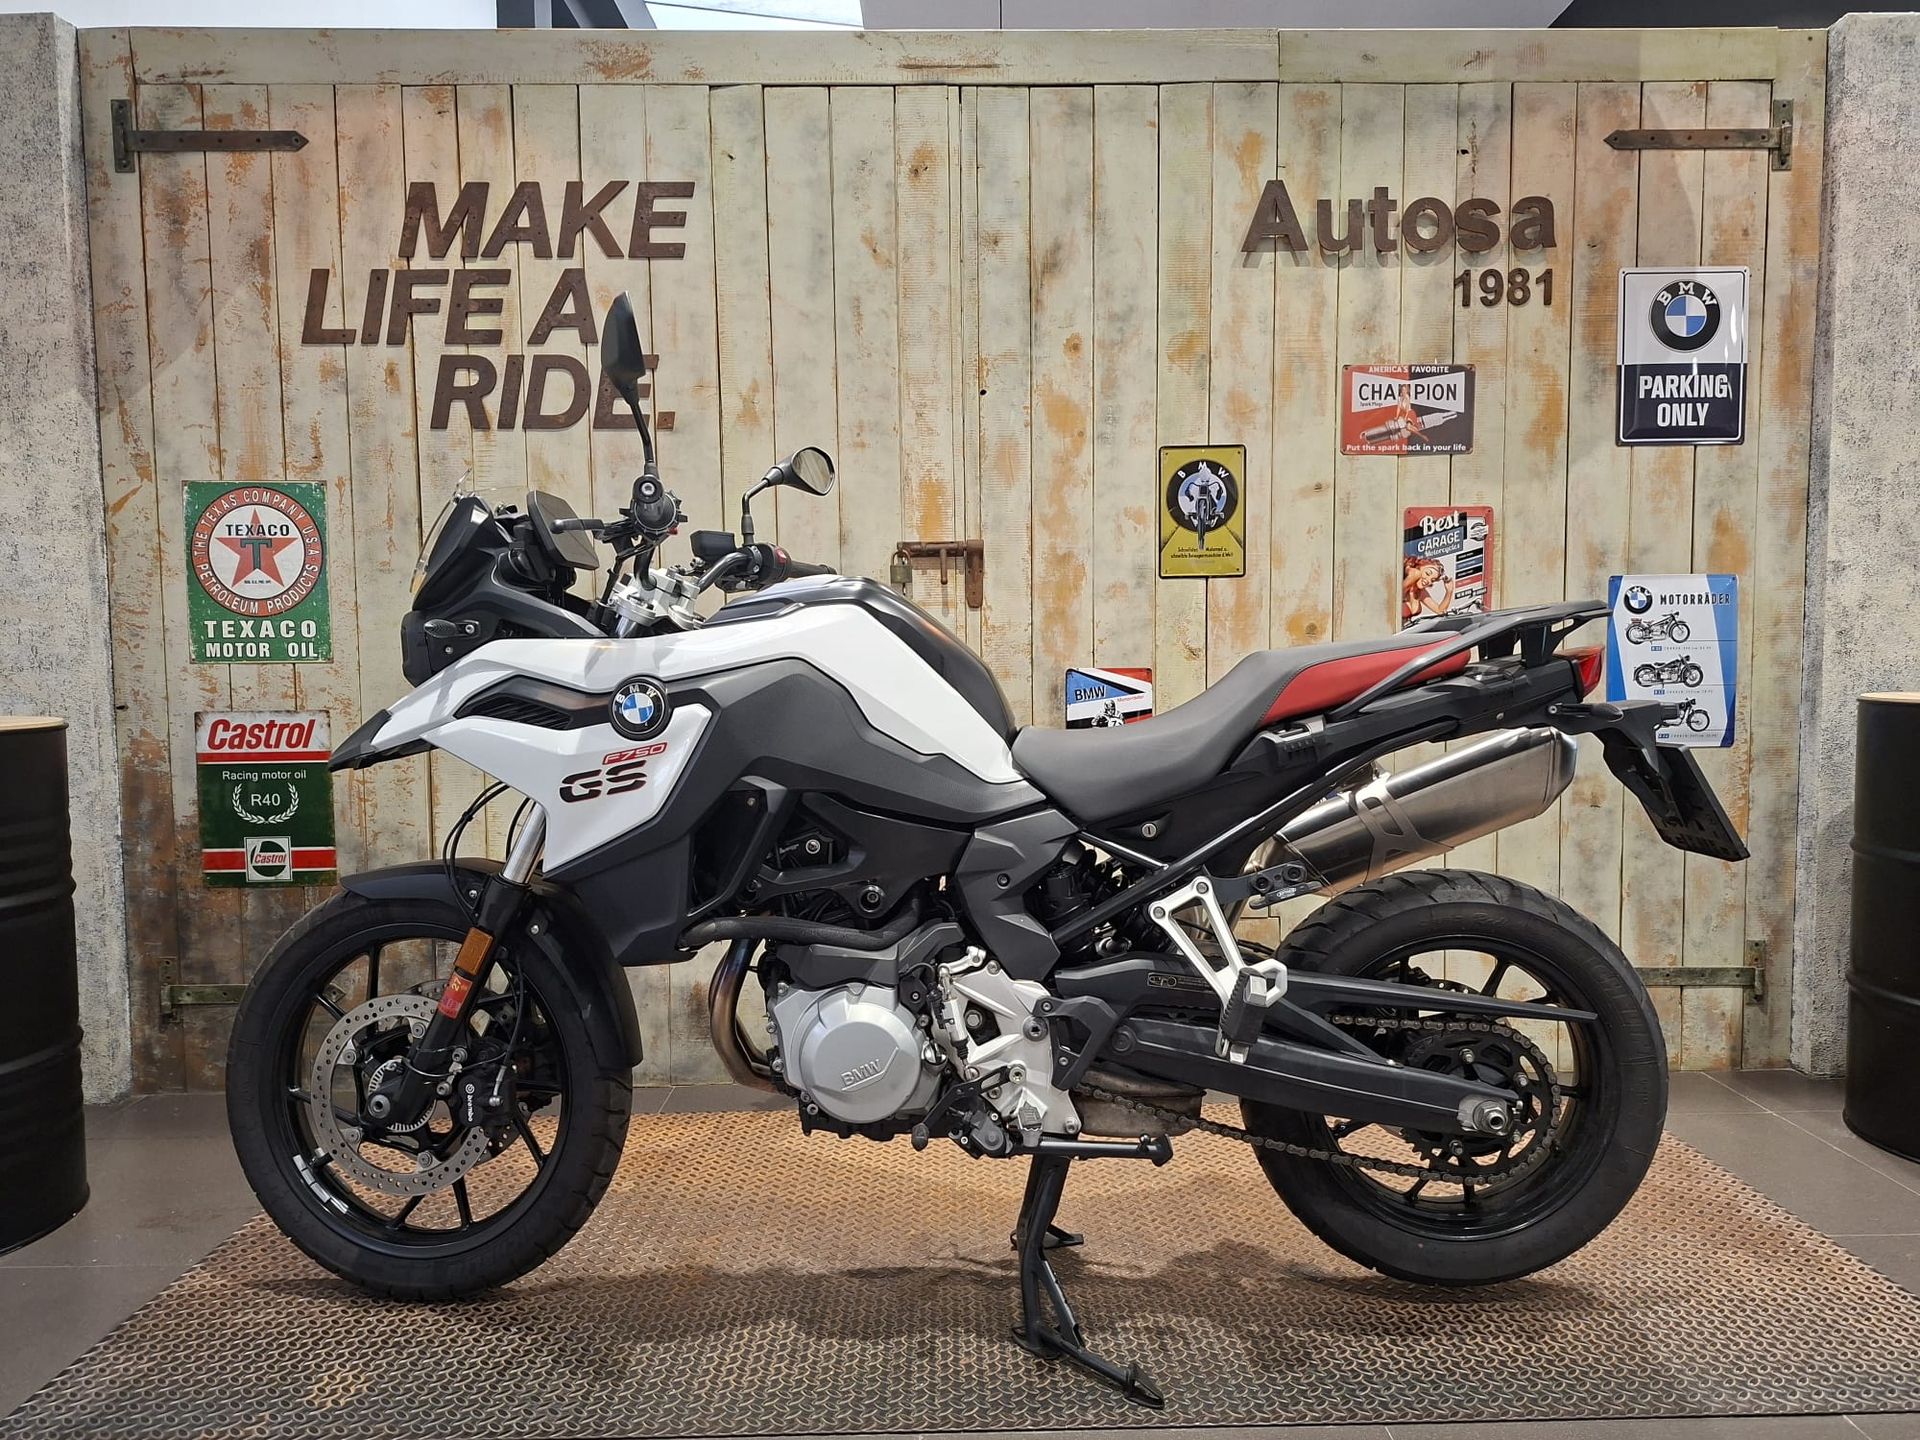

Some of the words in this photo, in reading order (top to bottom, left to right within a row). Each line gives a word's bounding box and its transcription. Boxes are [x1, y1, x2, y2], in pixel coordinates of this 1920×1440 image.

[398, 180, 696, 259] MAKE
[1240, 179, 1558, 252] Autosa
[1453, 268, 1554, 308] 1981
[1657, 282, 1718, 307] BMW
[301, 268, 512, 346] LIFE
[527, 268, 599, 345] A
[1639, 374, 1729, 399] PARKING
[1657, 402, 1710, 427] ONLY
[1362, 443, 1376, 451] the
[1378, 443, 1400, 454] spark
[1402, 443, 1421, 451] back
[1423, 443, 1431, 451] in
[1432, 445, 1451, 454] your
[1453, 443, 1466, 451] life
[1177, 461, 1230, 479] BMW
[194, 532, 208, 557] THE
[201, 494, 238, 528] TEXAS
[243, 490, 306, 521] COMPANY
[225, 524, 291, 536] TEXACO
[1420, 510, 1460, 535] Best
[1417, 530, 1461, 553] GARAGE
[198, 563, 259, 614] PETROLEUM
[267, 564, 319, 613] PRODUCTS
[204, 620, 317, 638] TEXACO
[205, 642, 271, 658] MOTOR
[287, 642, 318, 657] OIL
[615, 684, 657, 704] BMW
[1074, 685, 1105, 700] BMW
[207, 719, 316, 750] Castrol
[603, 743, 666, 764] F750
[222, 770, 259, 782] Racing
[262, 771, 291, 779] motor
[294, 769, 307, 779] oil
[559, 760, 647, 803] GS
[251, 793, 281, 806] R40
[254, 852, 287, 864] Castrol
[841, 1059, 880, 1086] BMW
